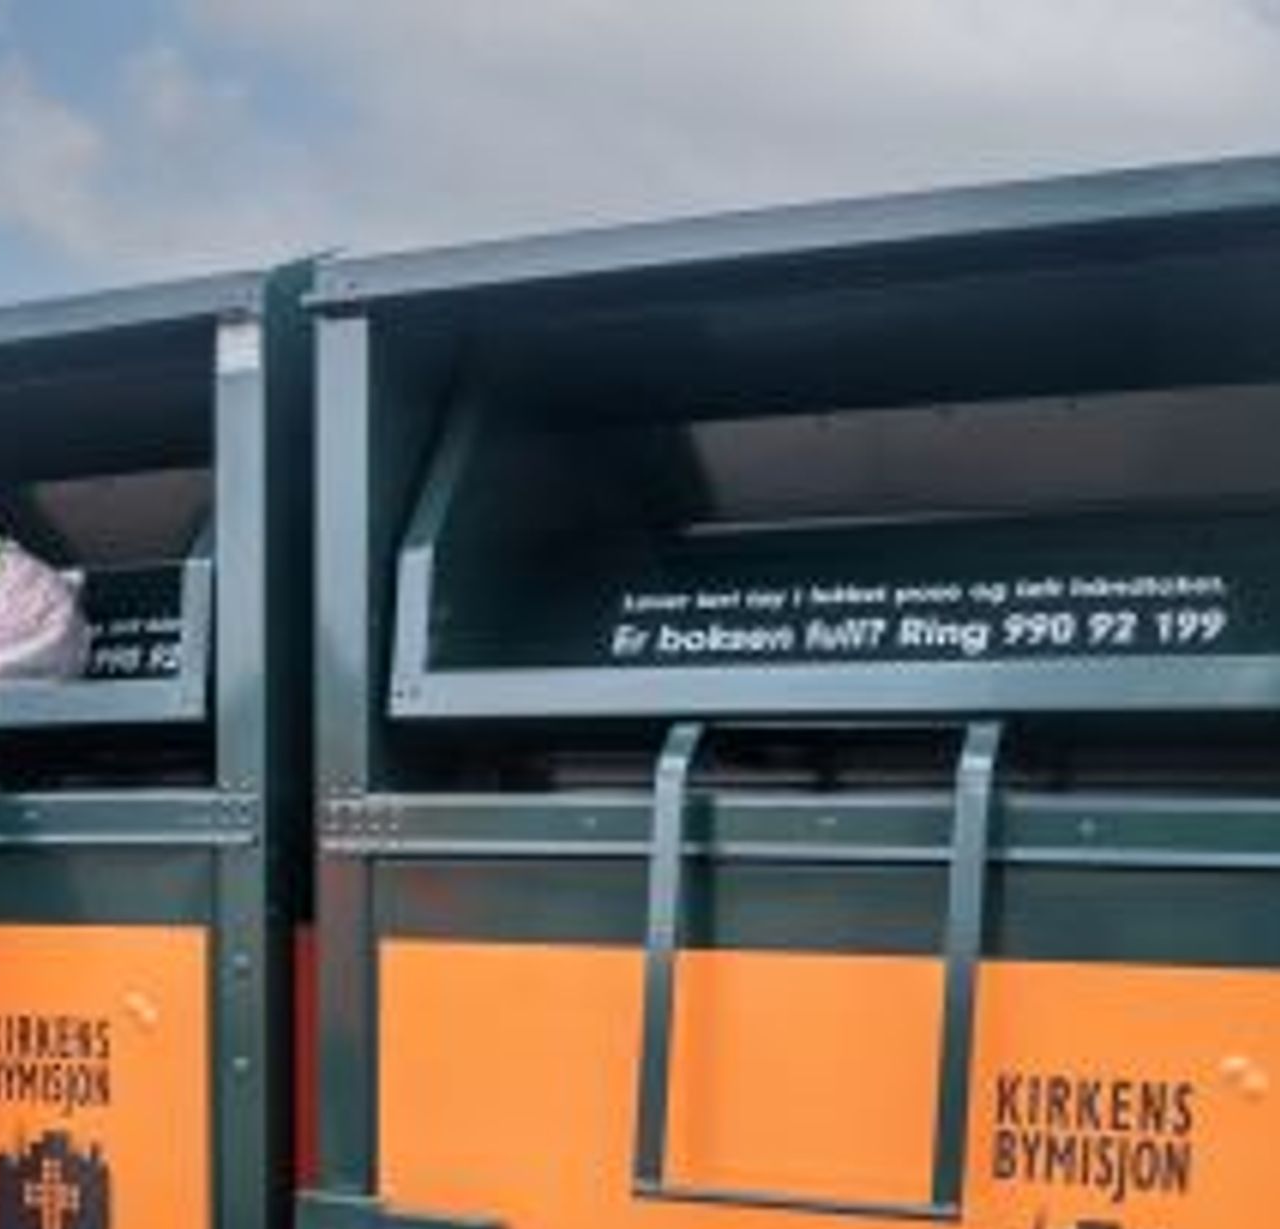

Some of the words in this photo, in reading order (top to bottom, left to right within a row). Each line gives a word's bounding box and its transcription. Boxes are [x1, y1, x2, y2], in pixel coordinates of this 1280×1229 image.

[612, 622, 650, 656] Er
[658, 622, 796, 652] boksen
[805, 617, 886, 651] full?
[900, 614, 992, 655] Ring
[1001, 611, 1077, 646] 990
[1087, 610, 1138, 645] 92
[1156, 606, 1228, 644] 199
[995, 1070, 1194, 1137] KIRKENS
